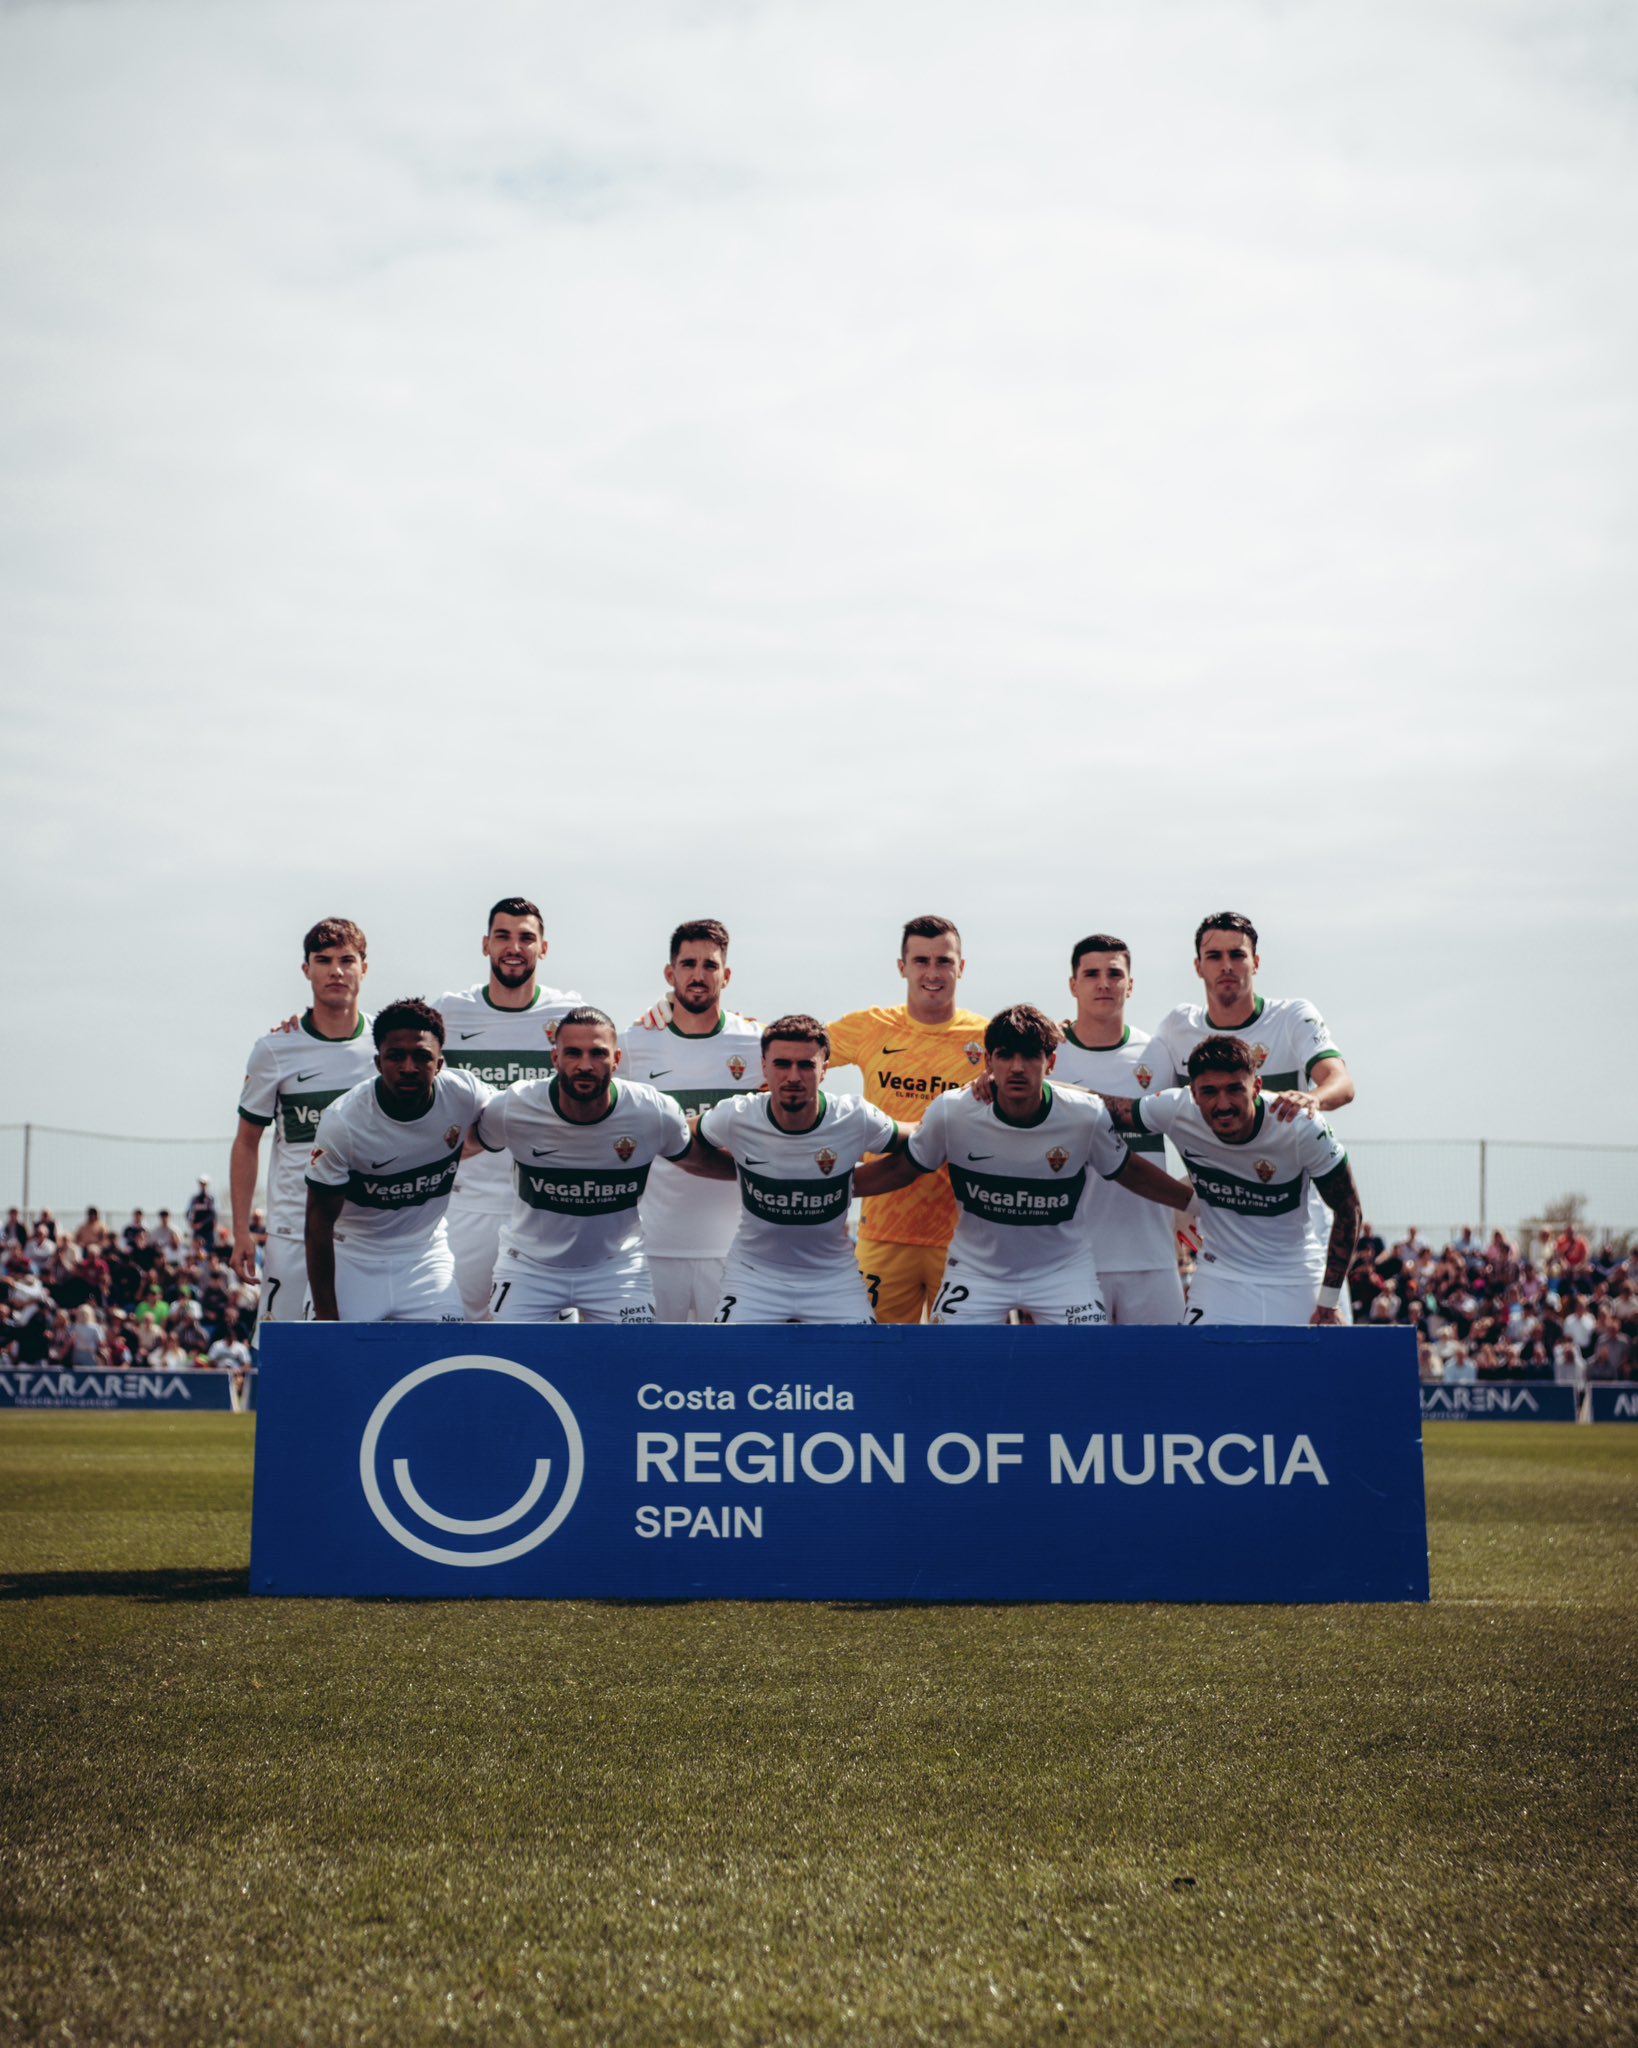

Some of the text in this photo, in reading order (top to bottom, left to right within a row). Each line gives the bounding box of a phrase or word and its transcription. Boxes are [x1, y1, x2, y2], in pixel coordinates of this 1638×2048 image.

[267, 1276, 281, 1312] 7
[933, 1281, 969, 1314] 12
[1066, 1302, 1093, 1317] Next
[637, 1383, 855, 1411] Costa Cálida
[636, 1431, 1329, 1486] REGION OF MURCIA
[634, 1505, 762, 1538] SPAIN
